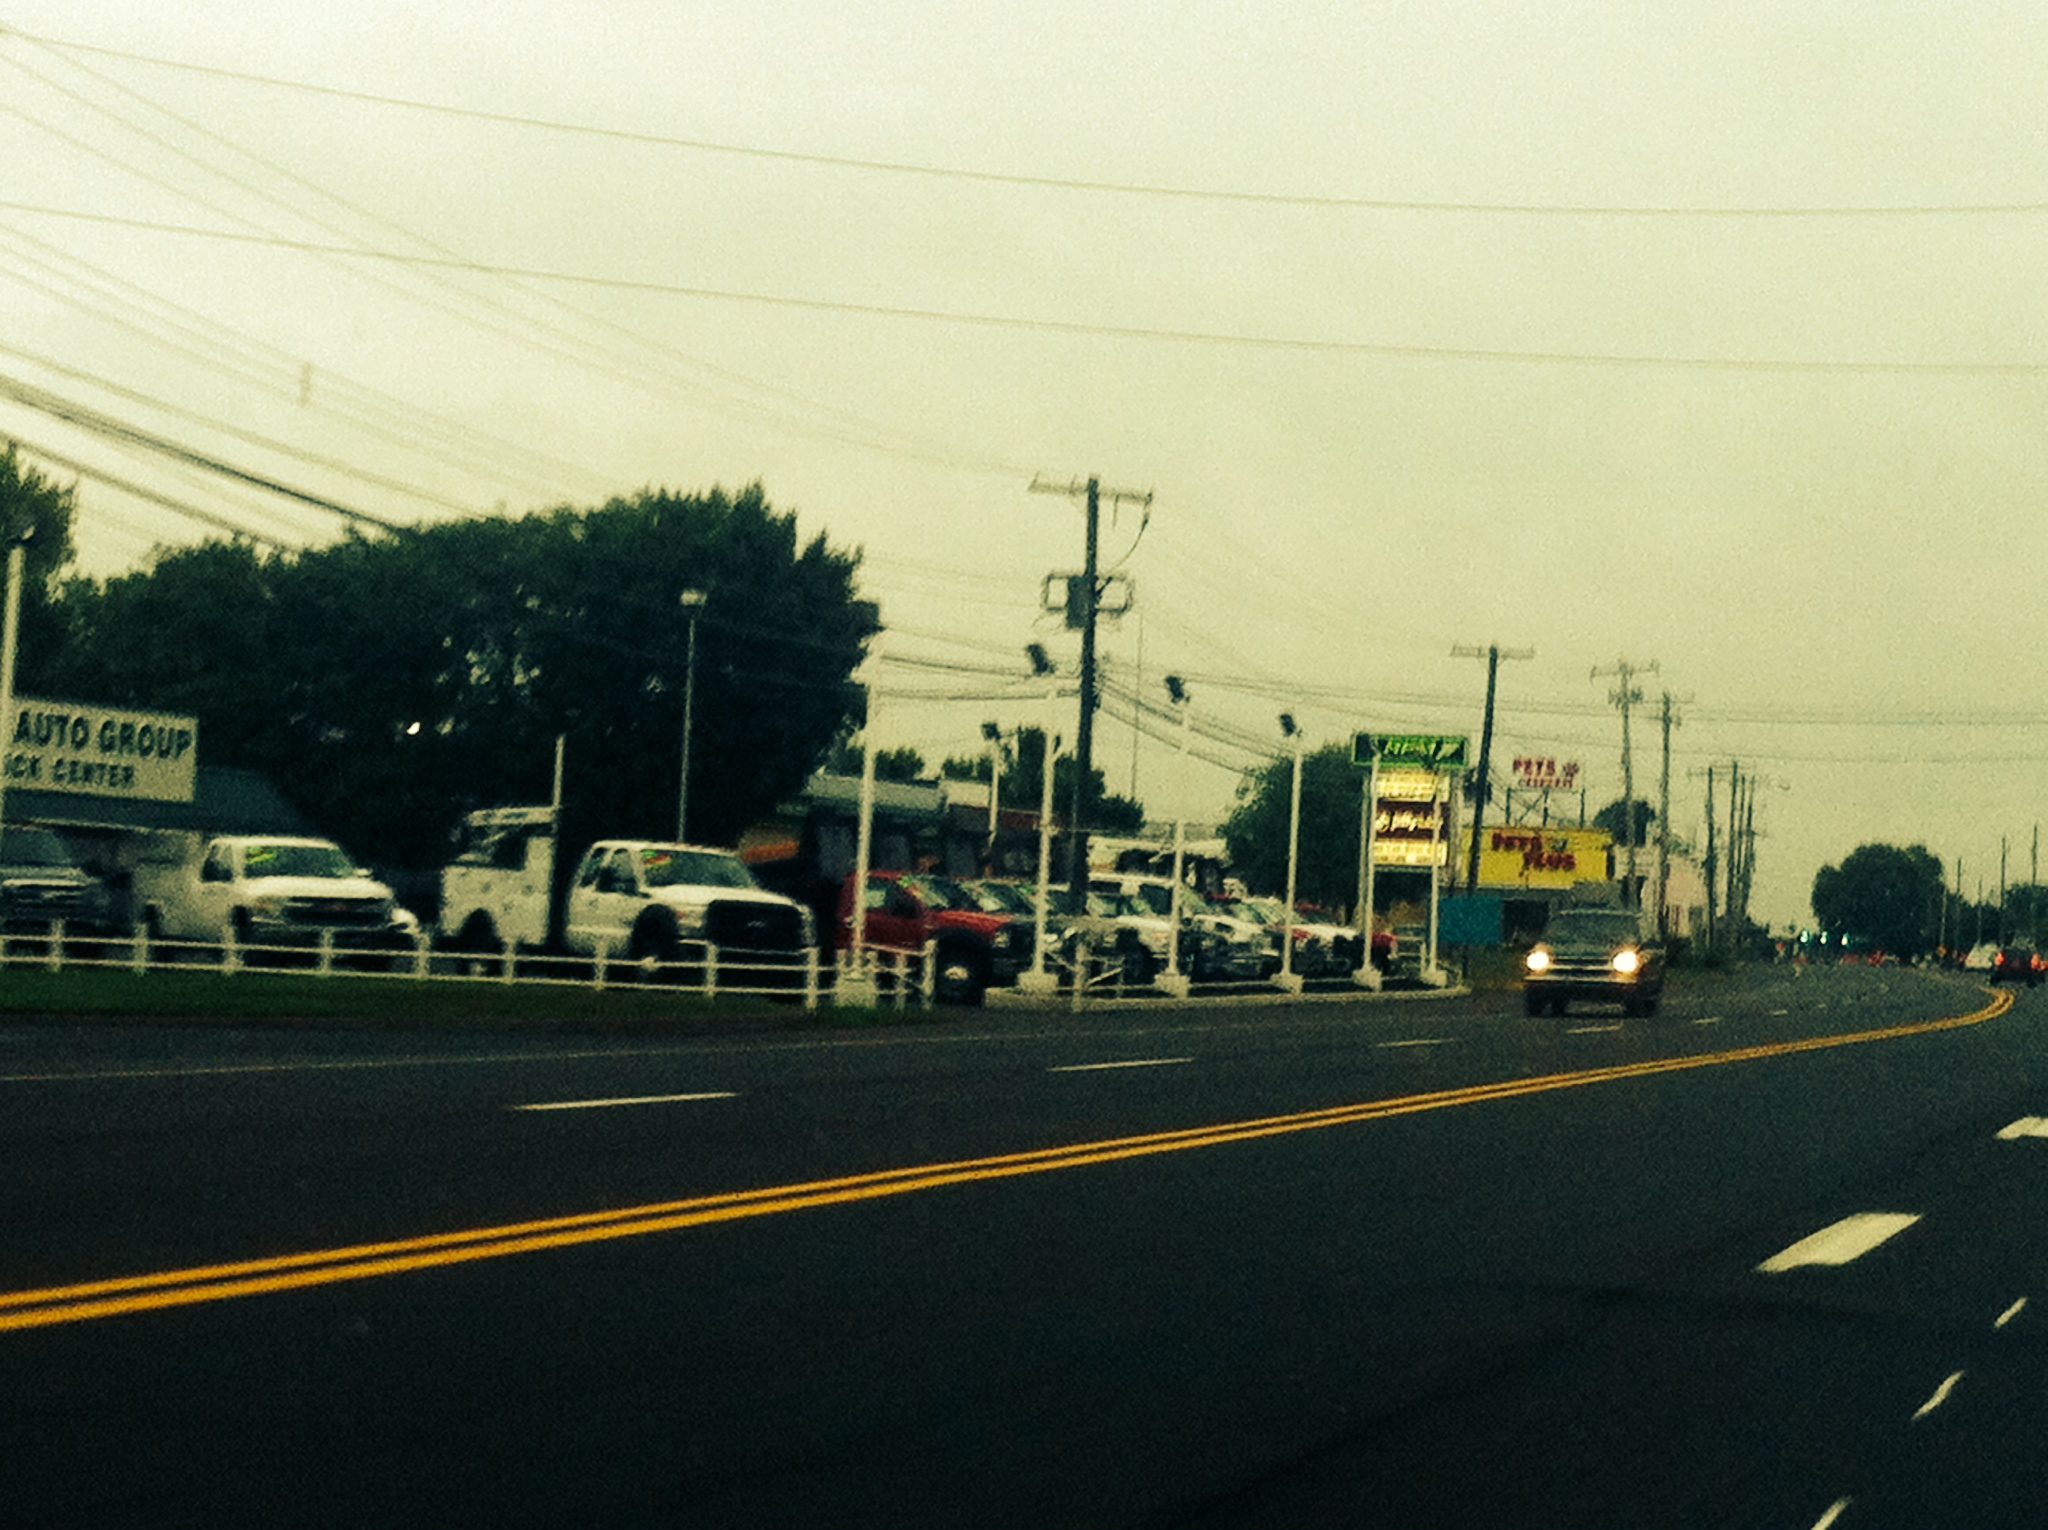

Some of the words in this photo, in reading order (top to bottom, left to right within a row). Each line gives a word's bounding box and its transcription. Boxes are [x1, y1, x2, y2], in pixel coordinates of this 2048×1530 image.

[13, 711, 90, 751] AUTO
[99, 720, 192, 759] GROUP
[52, 757, 135, 788] CENTER
